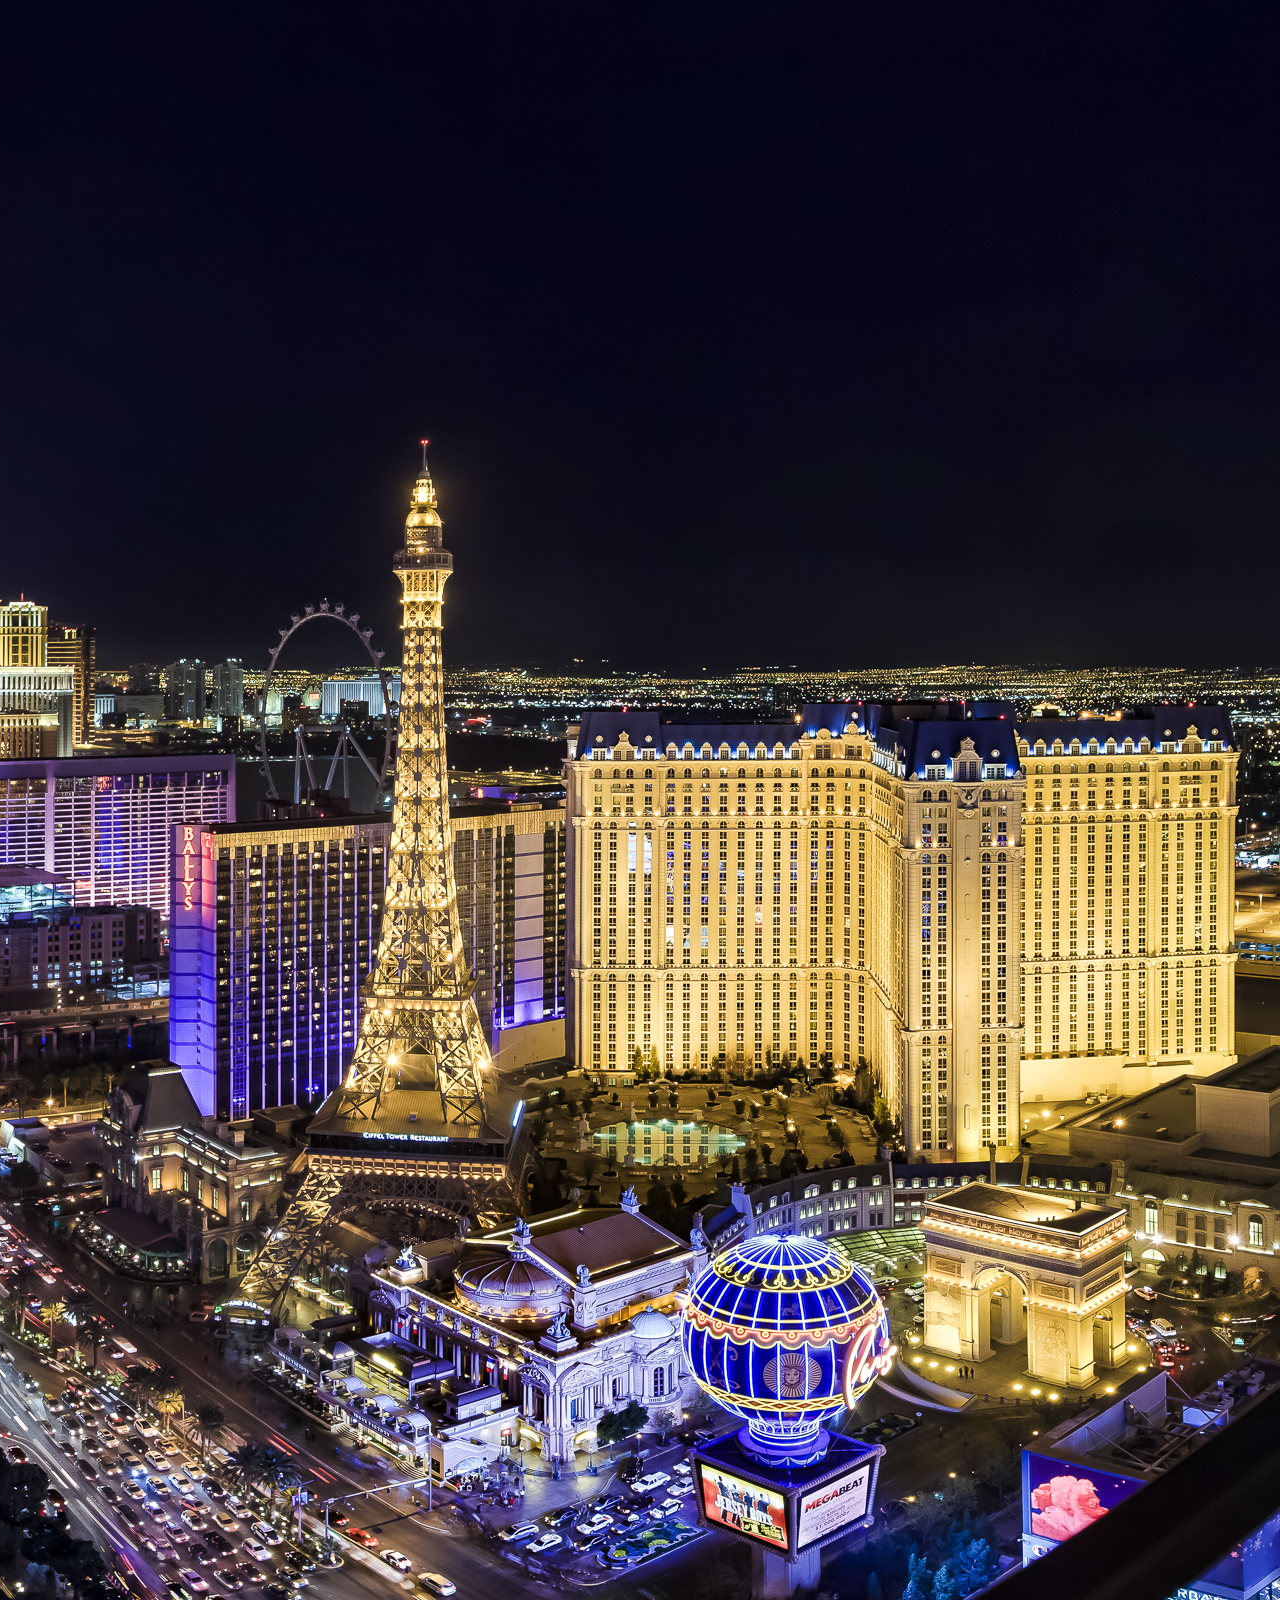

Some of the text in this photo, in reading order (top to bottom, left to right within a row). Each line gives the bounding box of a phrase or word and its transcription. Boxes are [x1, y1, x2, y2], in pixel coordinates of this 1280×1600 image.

[182, 826, 195, 911] BALLYS
[1033, 1319, 1066, 1331] GORDON
[845, 1323, 897, 1410] Paris
[715, 1494, 774, 1526] JERSEY BOYS
[805, 1476, 864, 1513] MEGABEAT
